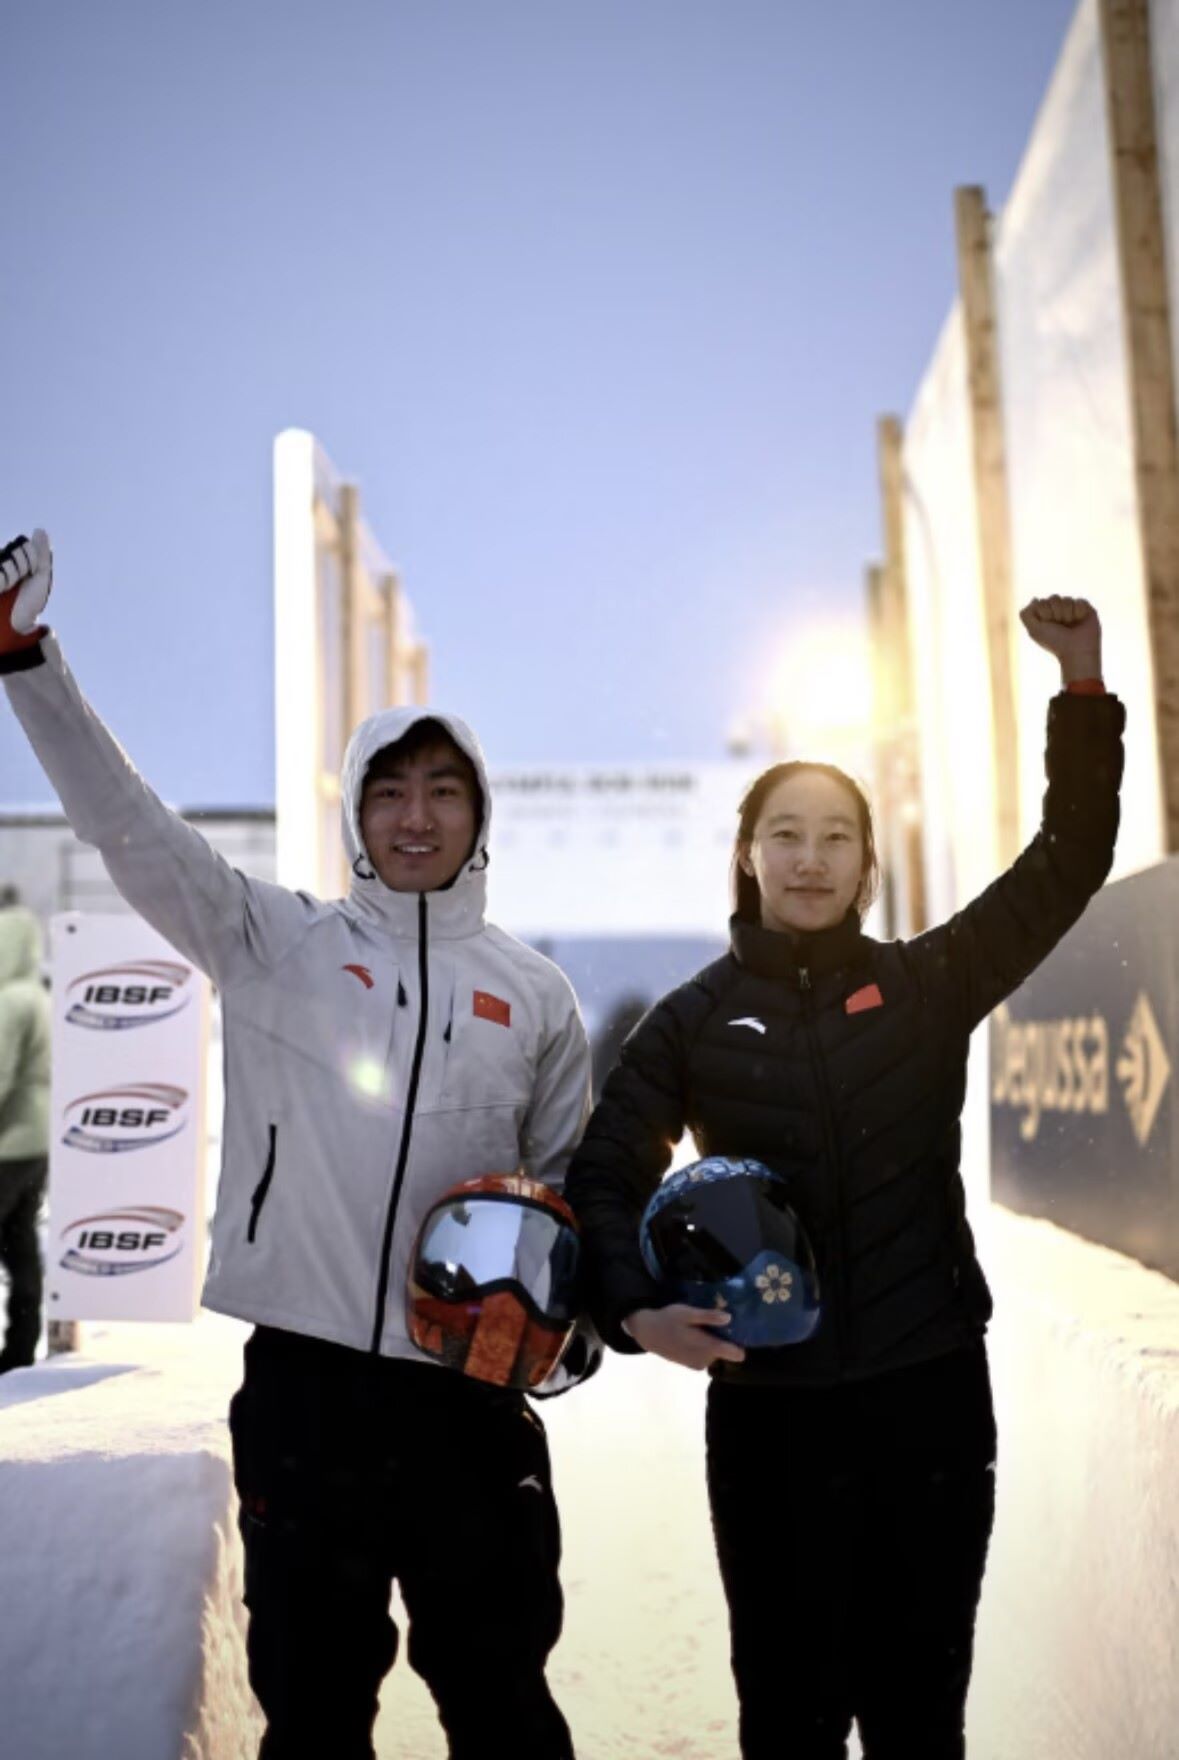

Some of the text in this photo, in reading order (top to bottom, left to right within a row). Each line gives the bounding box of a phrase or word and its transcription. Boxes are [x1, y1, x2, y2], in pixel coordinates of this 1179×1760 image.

[84, 985, 173, 1005] IBSF
[81, 1108, 170, 1128] IBSF
[77, 1231, 167, 1251] IBSF
